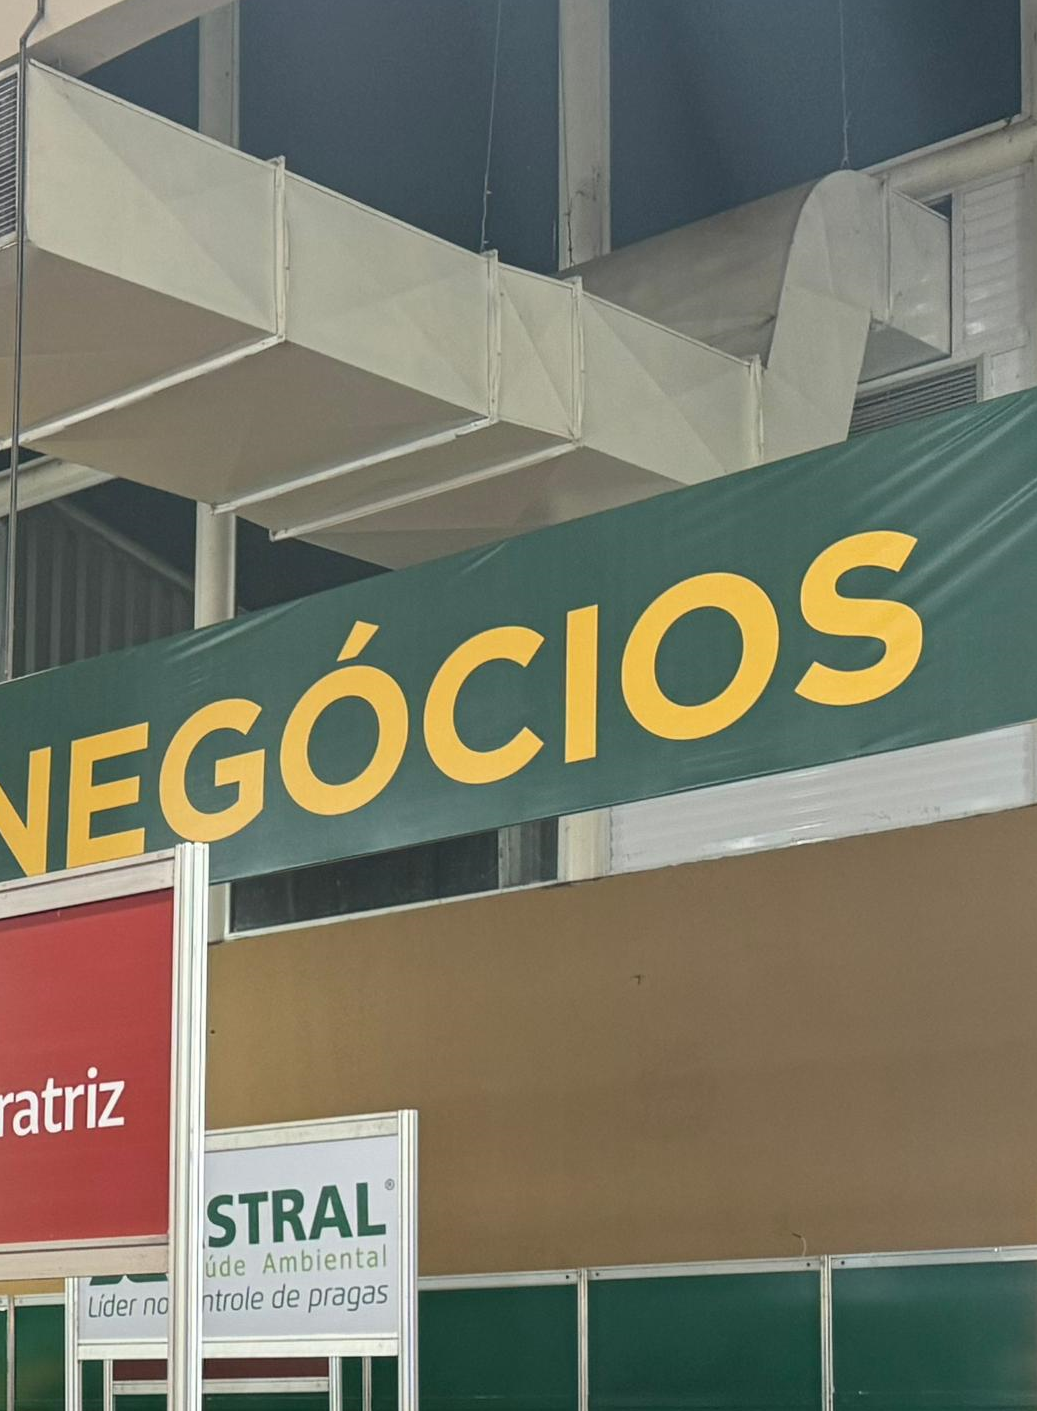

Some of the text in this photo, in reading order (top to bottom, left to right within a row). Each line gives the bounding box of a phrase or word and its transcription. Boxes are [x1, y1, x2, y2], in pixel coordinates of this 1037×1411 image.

[204, 1182, 387, 1249] STRAL
[205, 1244, 387, 1278] úde Ambiental
[88, 1283, 389, 1318] Líder no ntrole de pragas
